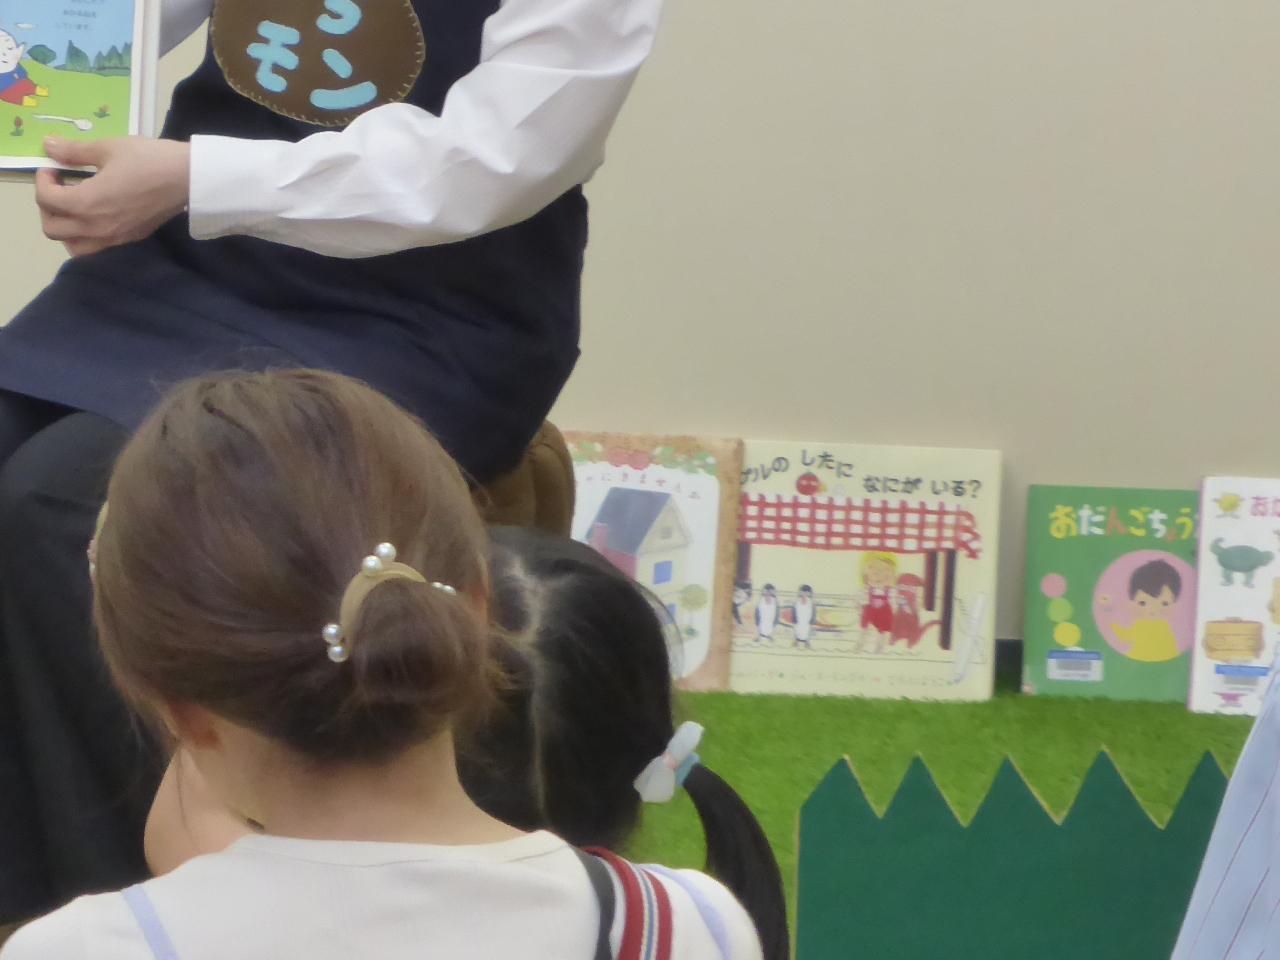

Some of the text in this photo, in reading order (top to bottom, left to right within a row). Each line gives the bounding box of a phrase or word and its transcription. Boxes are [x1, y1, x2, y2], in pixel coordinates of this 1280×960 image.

[801, 449, 854, 479] したに
[862, 473, 923, 495] なにが
[1049, 503, 1198, 543] おだんごちょう
